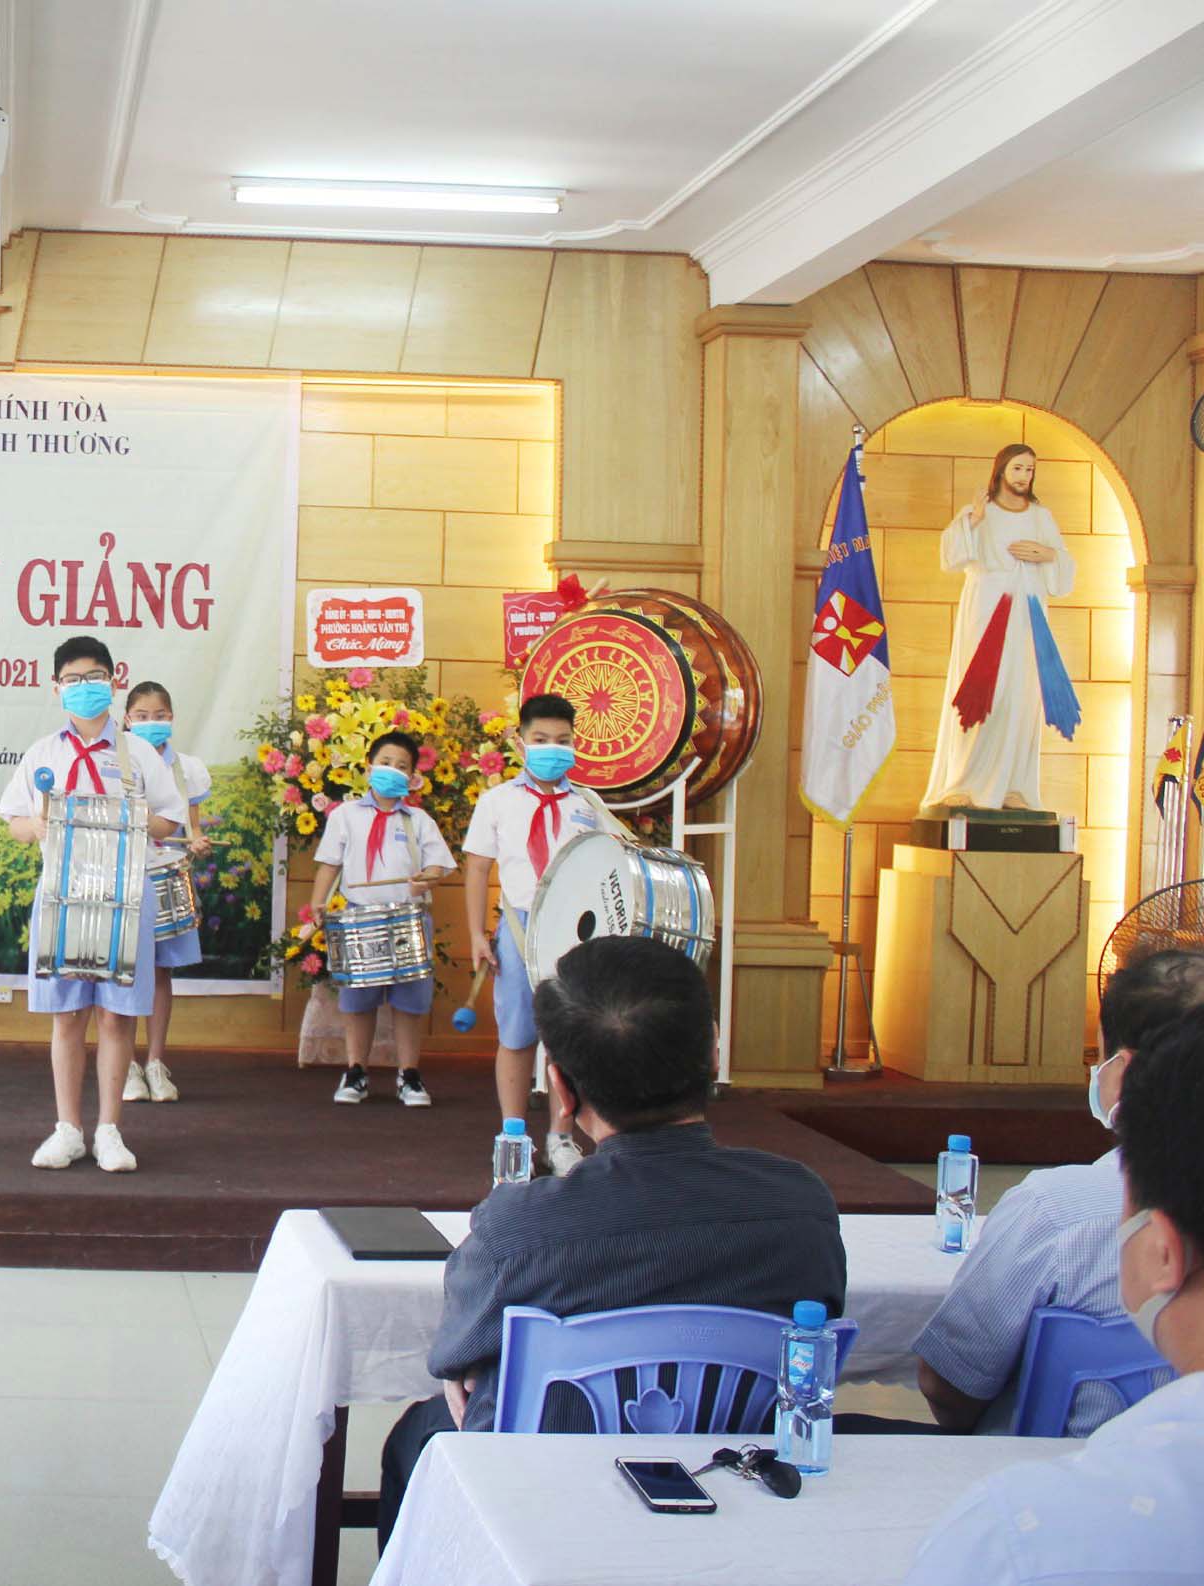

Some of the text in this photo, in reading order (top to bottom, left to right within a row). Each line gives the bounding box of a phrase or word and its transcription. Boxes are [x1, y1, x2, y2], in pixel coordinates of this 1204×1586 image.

[58, 395, 108, 422] TÒA
[27, 430, 131, 456] THƯƠNG
[16, 531, 215, 632] GIẢNG
[608, 868, 629, 935] VICTORIA
